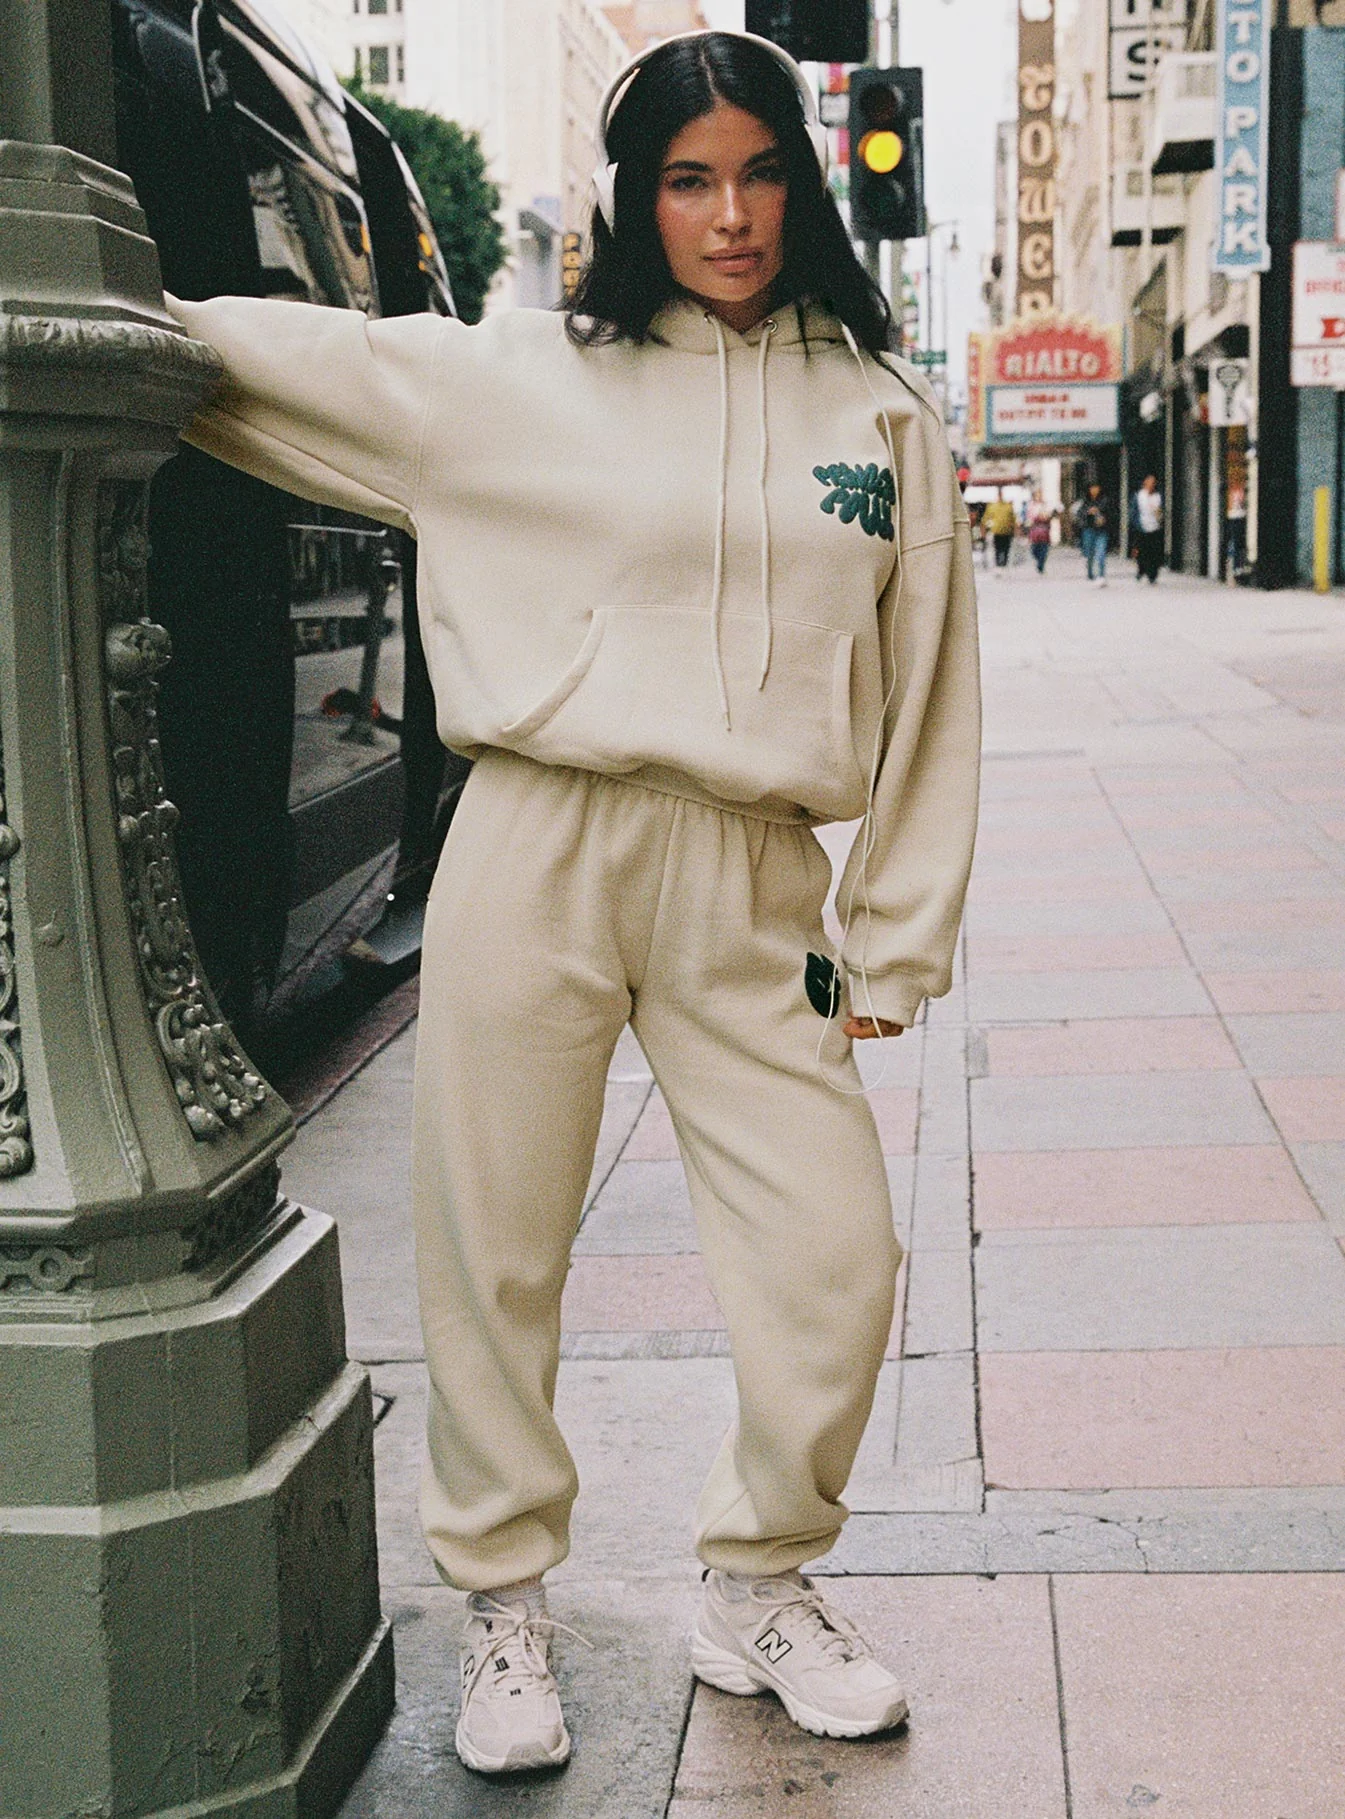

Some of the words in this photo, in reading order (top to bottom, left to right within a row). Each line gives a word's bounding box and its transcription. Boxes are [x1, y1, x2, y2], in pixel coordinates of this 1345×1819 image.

[1225, 105, 1259, 254] PARK
[1004, 348, 1100, 378] RIALTO
[754, 1627, 793, 1664] N
